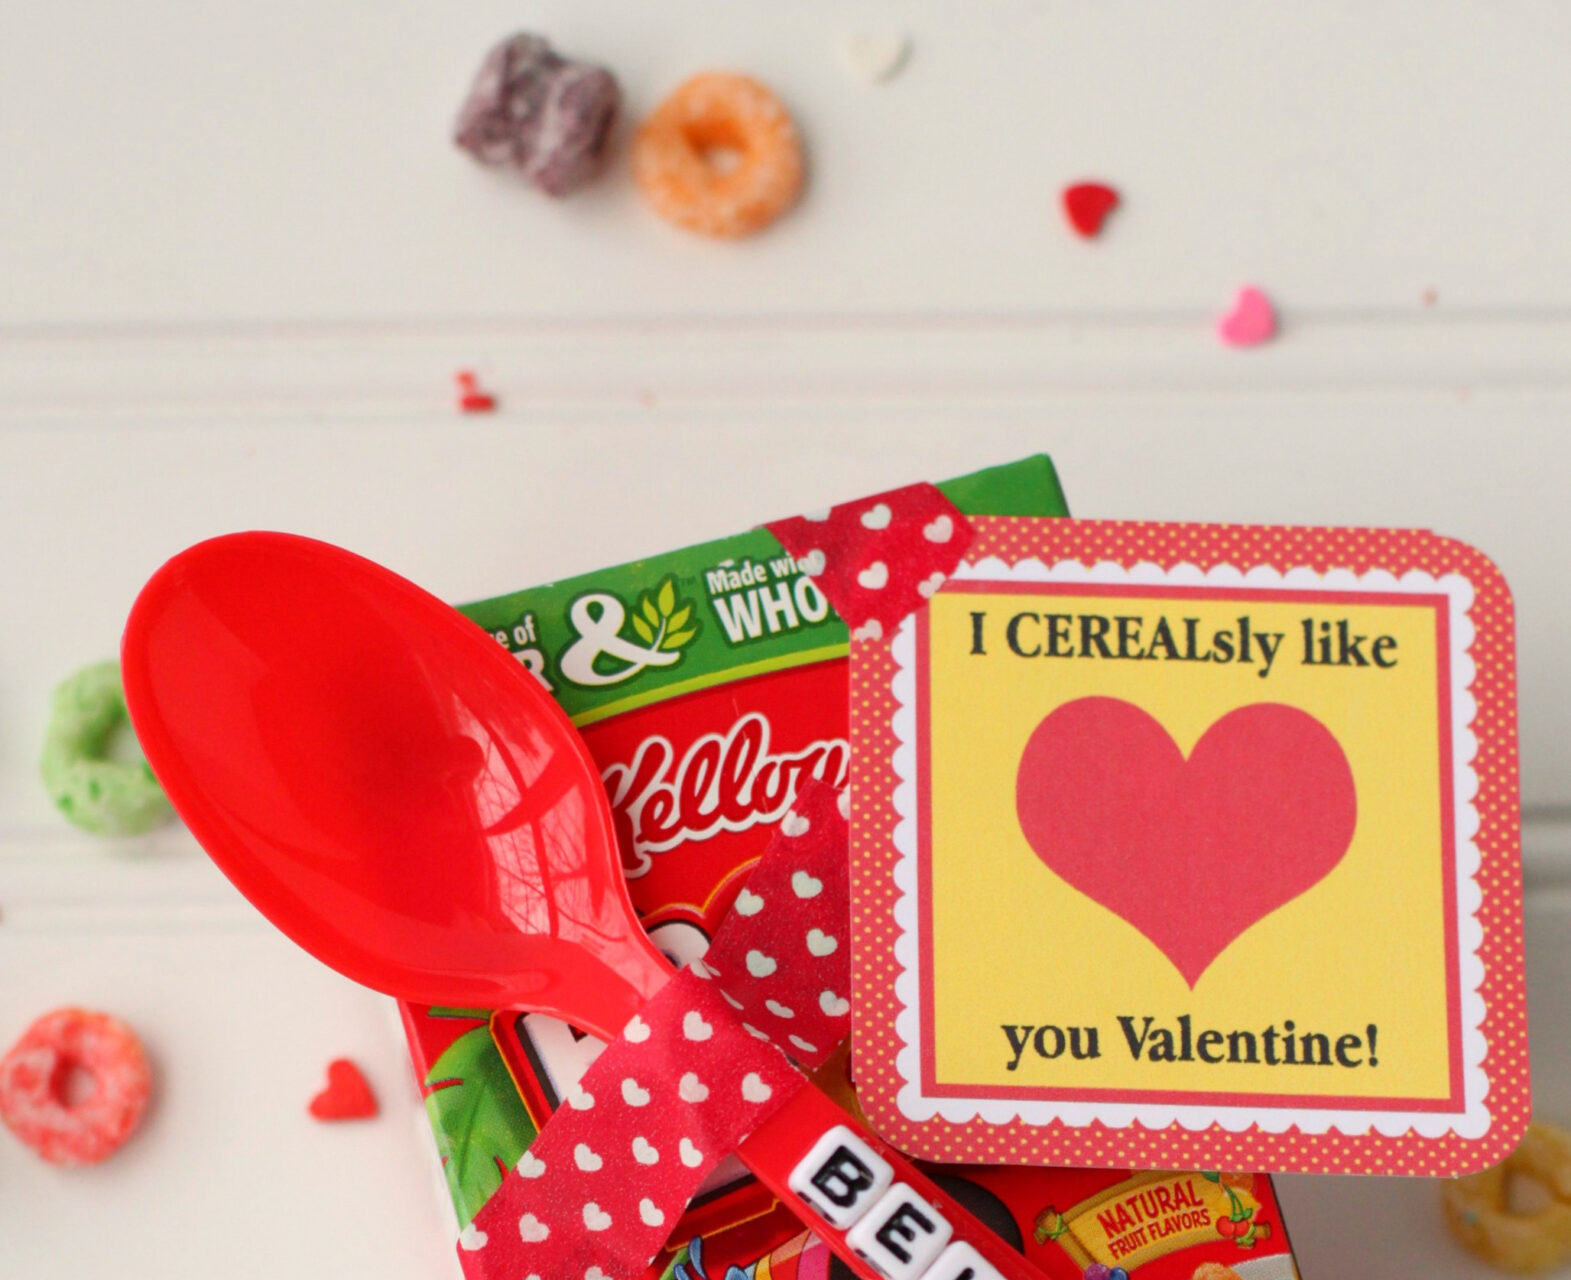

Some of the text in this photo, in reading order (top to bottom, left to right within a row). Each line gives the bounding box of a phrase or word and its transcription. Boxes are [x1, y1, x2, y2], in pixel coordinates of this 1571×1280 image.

[705, 559, 768, 595] Made
[513, 614, 537, 646] of
[712, 575, 840, 644] WHO
[968, 610, 1400, 679] I CEREALsly like
[1001, 1013, 1380, 1071] you Valentine!
[1096, 1178, 1205, 1240] NATURAL
[1107, 1207, 1211, 1261] FRUIT FLAVORS
